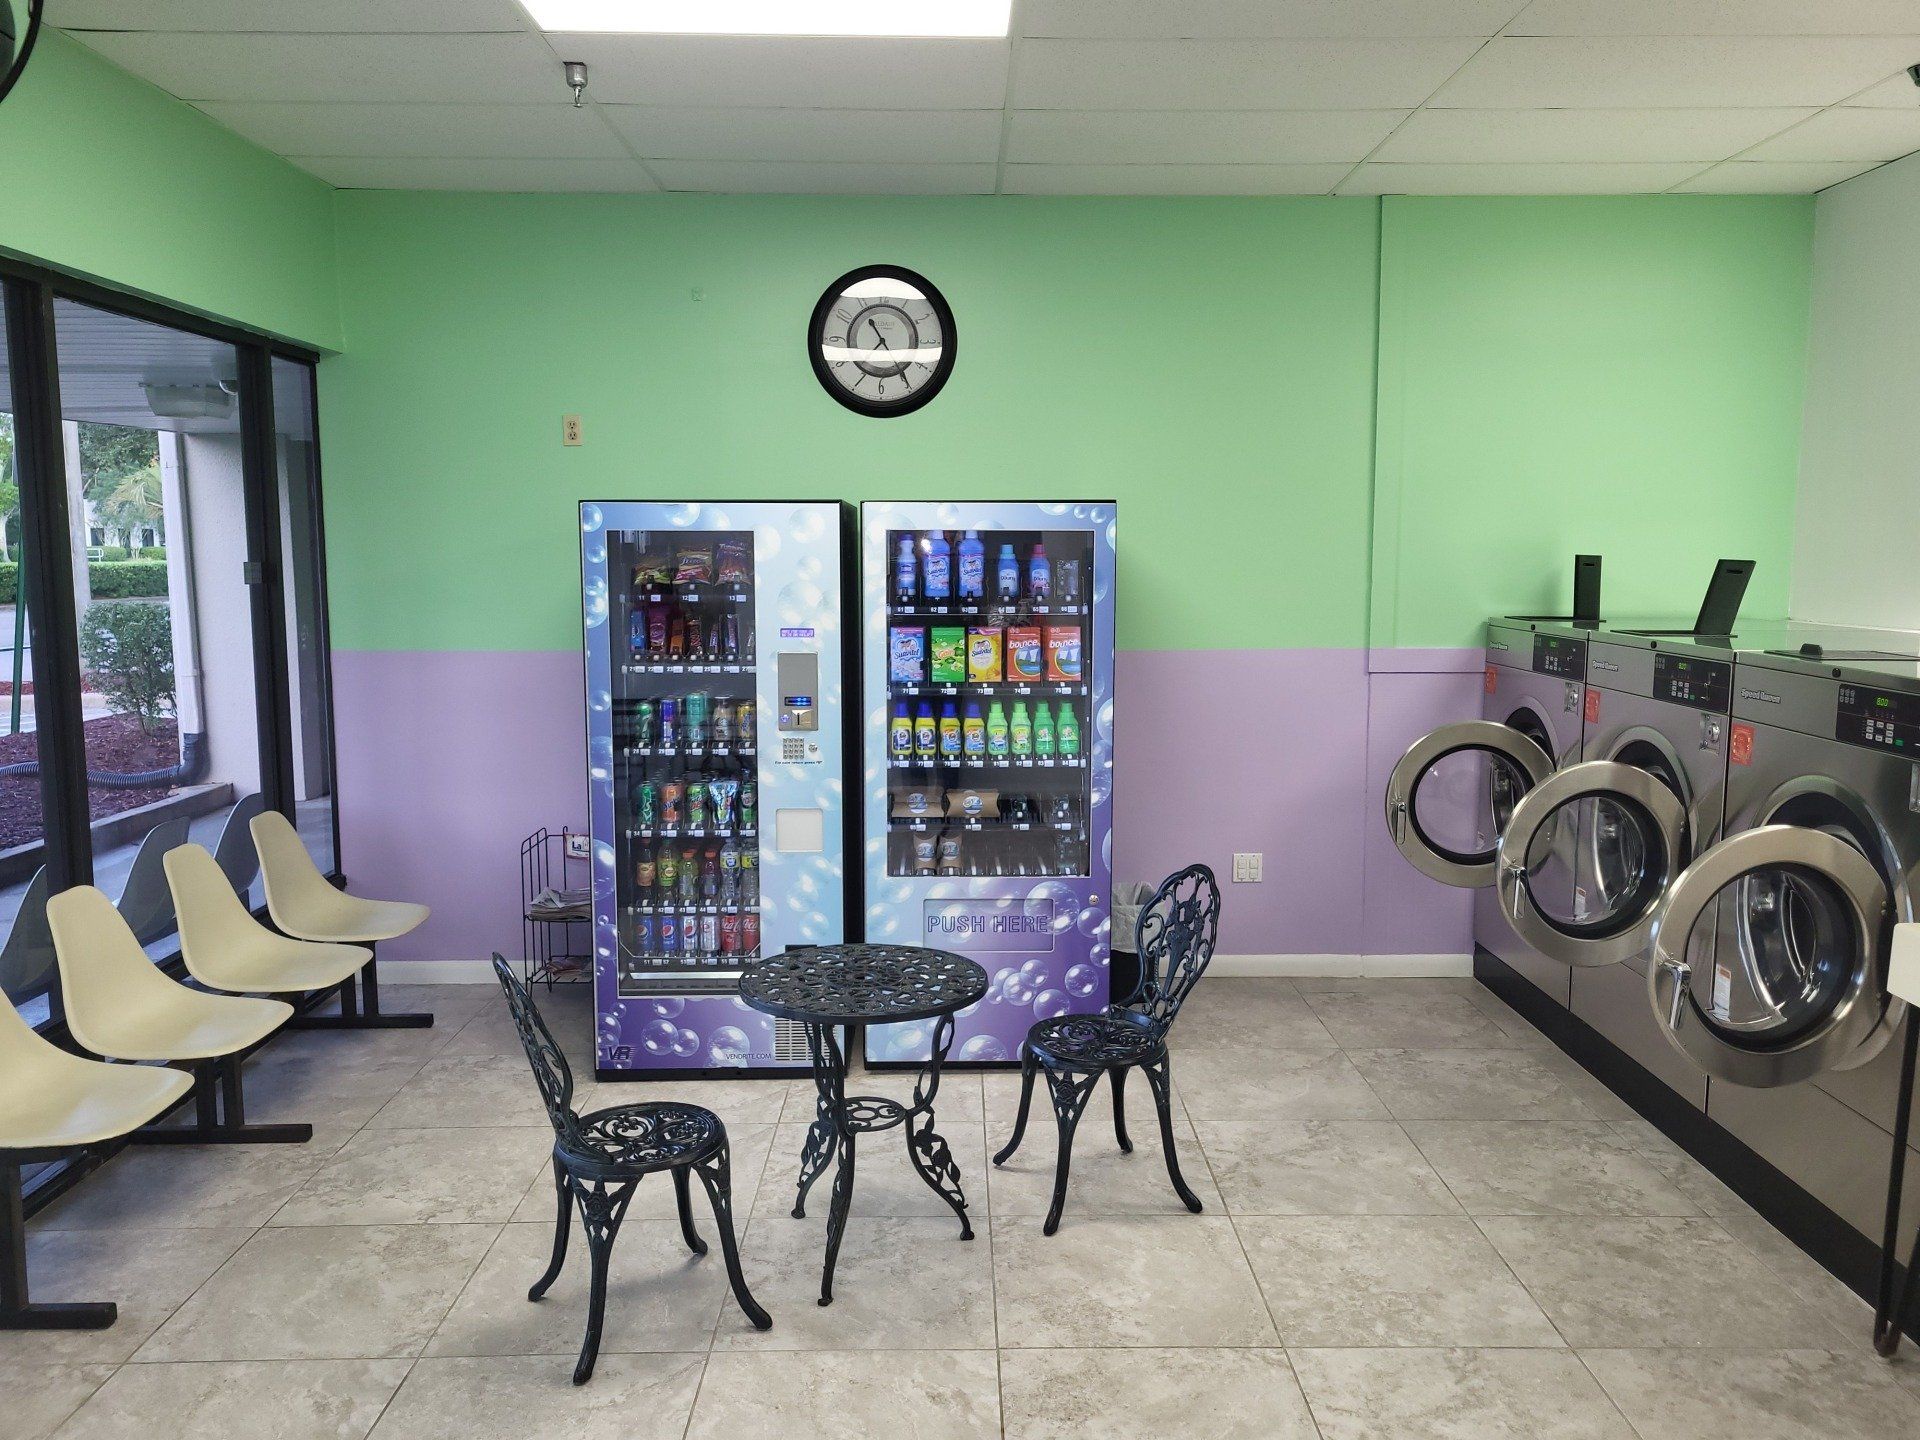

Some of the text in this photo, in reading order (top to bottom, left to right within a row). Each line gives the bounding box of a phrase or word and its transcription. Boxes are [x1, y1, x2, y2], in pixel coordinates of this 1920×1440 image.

[855, 372, 867, 388] 7
[878, 377, 885, 395] 6
[1008, 639, 1039, 649] bounce
[1048, 639, 1079, 649] bounce
[1741, 687, 1760, 700] Speed
[927, 915, 1048, 933] PUSH HERE
